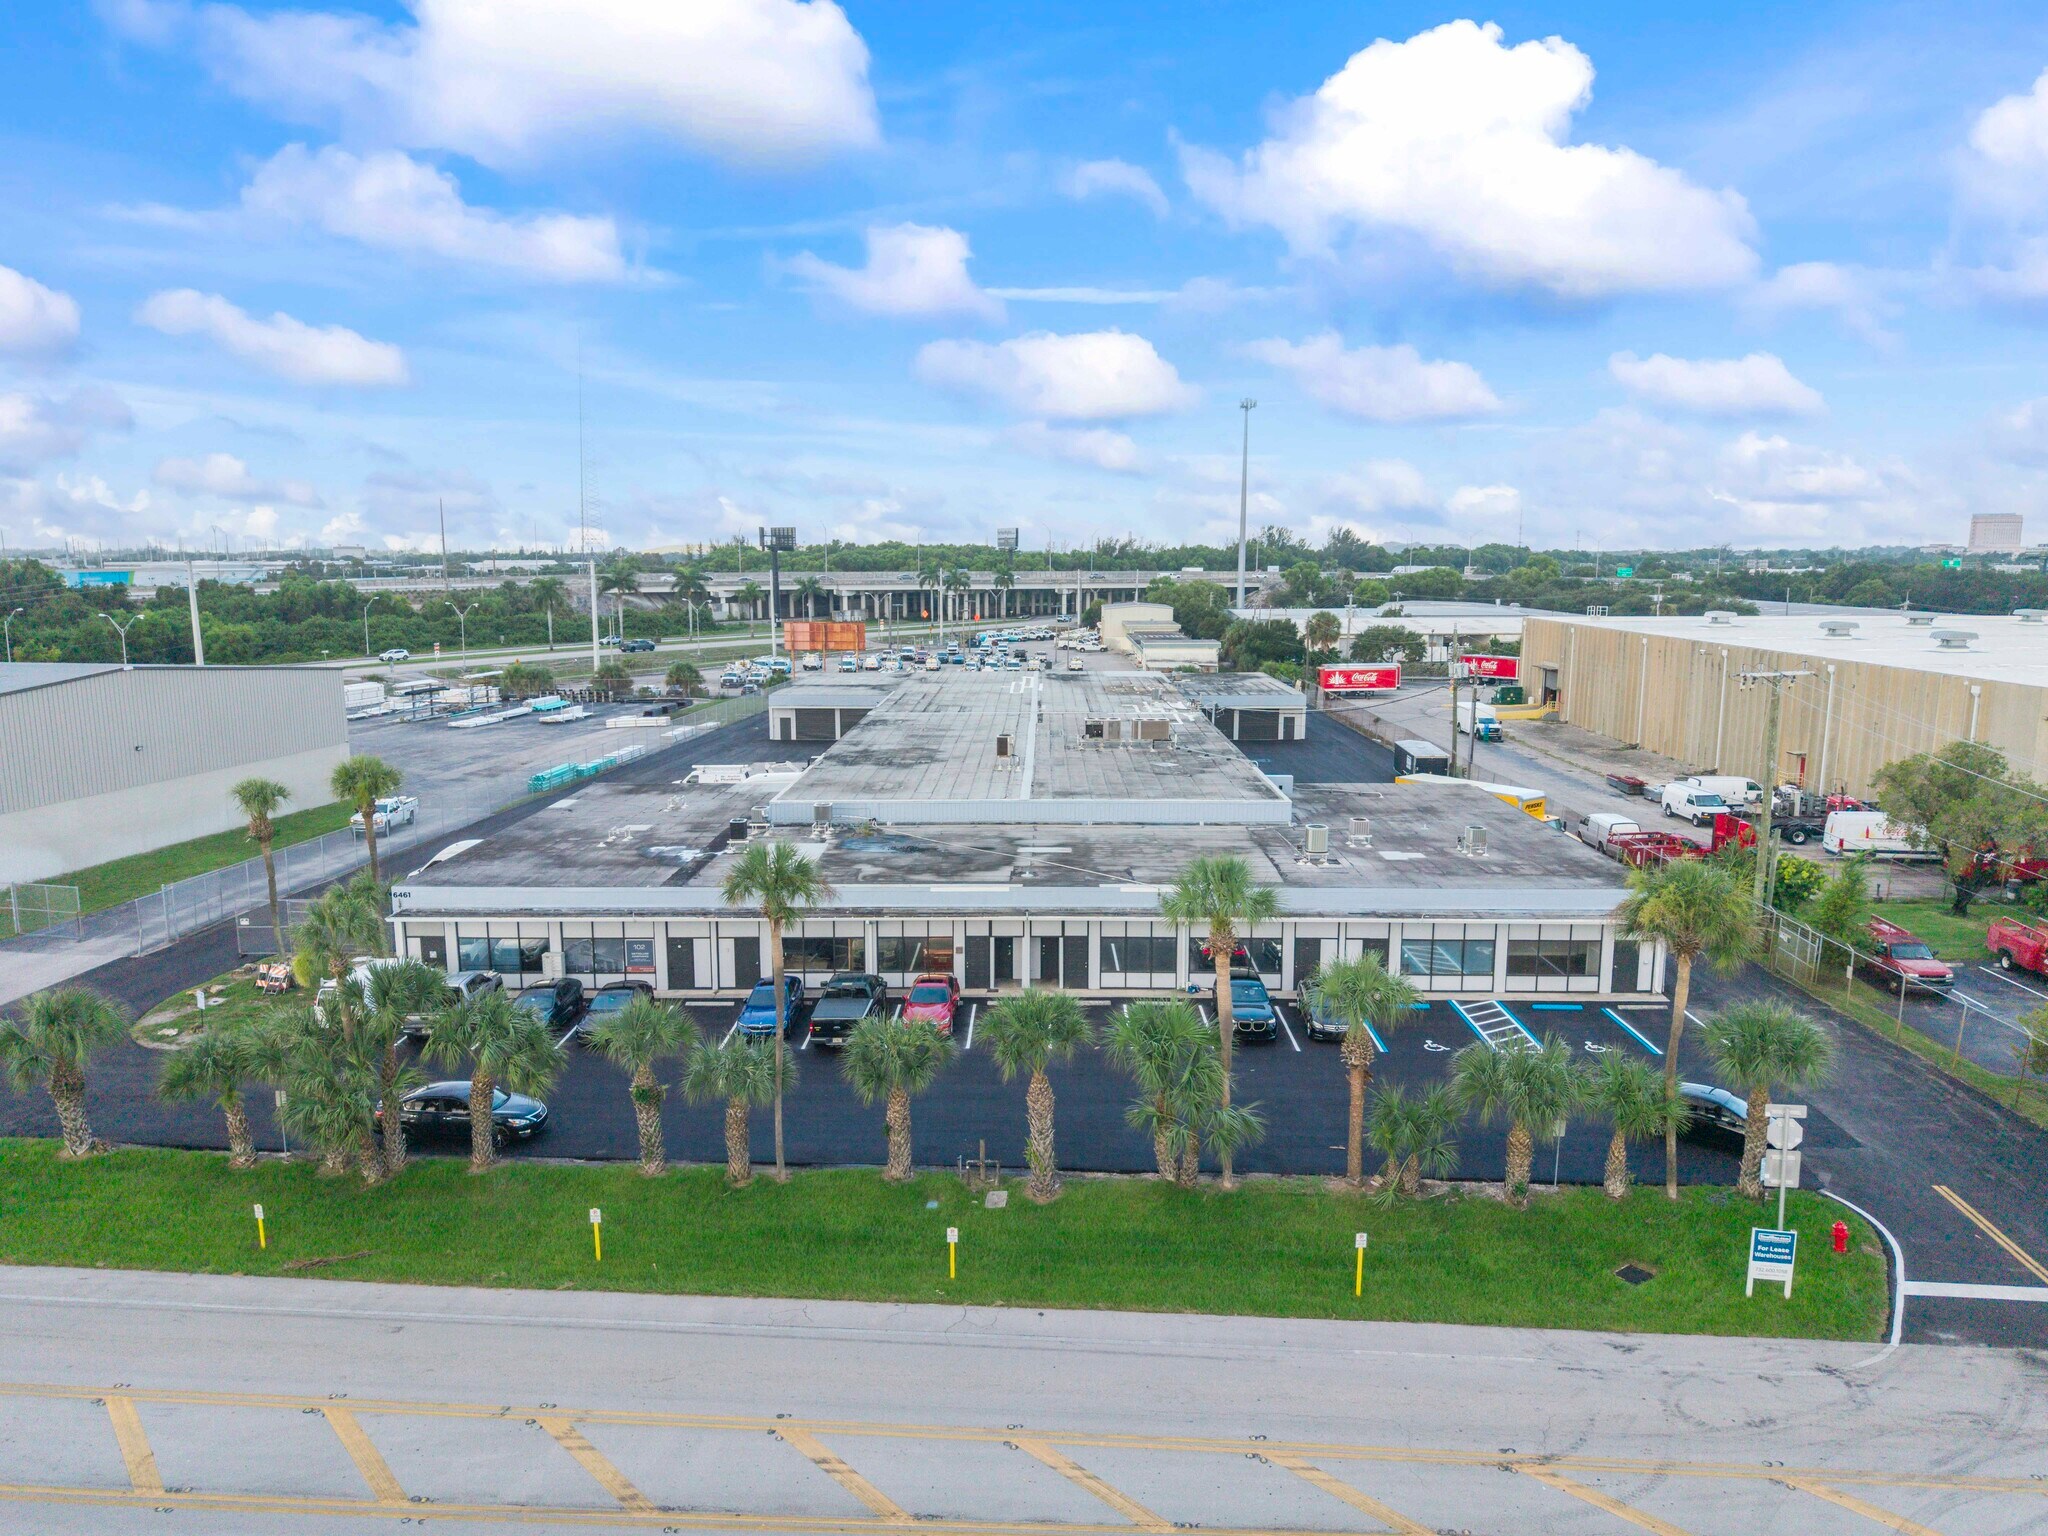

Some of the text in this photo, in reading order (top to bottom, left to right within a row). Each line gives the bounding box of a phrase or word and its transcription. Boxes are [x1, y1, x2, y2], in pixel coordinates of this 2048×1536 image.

[1525, 802, 1543, 810] PENSKE
[393, 891, 411, 899] 6461
[1754, 1252, 1792, 1260] Warehouses
